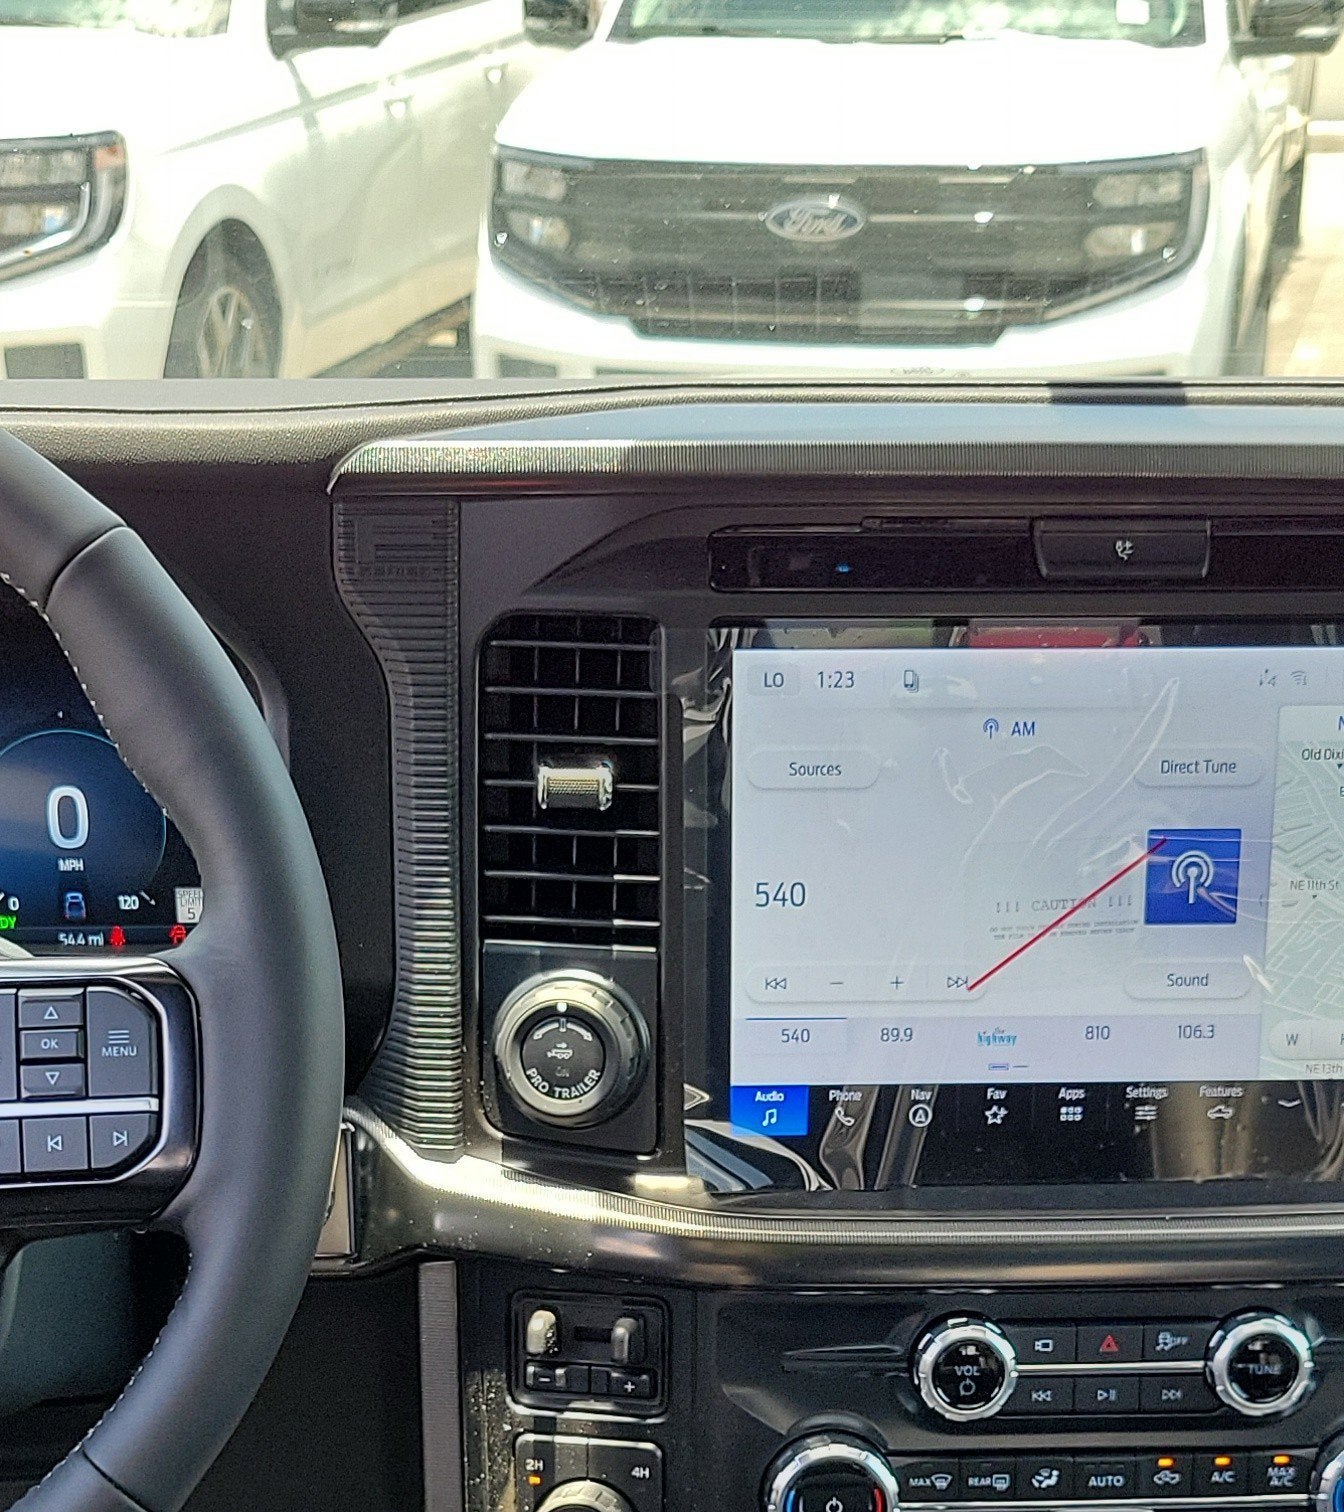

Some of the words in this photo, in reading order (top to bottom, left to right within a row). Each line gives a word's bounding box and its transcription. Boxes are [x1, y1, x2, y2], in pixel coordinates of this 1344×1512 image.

[762, 672, 785, 689] LO
[816, 671, 856, 689] 1:23
[1010, 721, 1037, 737] AM
[1301, 748, 1322, 761] Old
[788, 761, 843, 777] Sources
[1159, 759, 1200, 775] Direct
[1202, 759, 1238, 775] Tune
[46, 784, 90, 850] 0
[58, 858, 85, 872] MPH
[1289, 880, 1306, 891] NE
[1327, 880, 1340, 891] St
[754, 881, 807, 908] 540
[7, 896, 20, 911] 0
[118, 895, 140, 911] 120
[187, 907, 196, 920] 5
[87, 932, 104, 947] mi
[1166, 973, 1209, 987] Sound
[780, 1028, 811, 1043] 540
[879, 1027, 914, 1042] 89.9
[1085, 1025, 1111, 1040] 810
[1177, 1024, 1215, 1039] 106.3
[40, 1038, 60, 1050] OK
[977, 1030, 1017, 1047] highway
[1285, 1033, 1299, 1046] W
[101, 1046, 138, 1058] MENU
[1305, 1064, 1321, 1075] NE
[1322, 1064, 1343, 1075] 13th
[525, 1067, 550, 1094] PRO
[553, 1068, 602, 1099] TRAILER
[754, 1090, 785, 1103] Audio
[828, 1089, 863, 1102] Phone
[910, 1089, 933, 1101] Nav
[986, 1088, 1007, 1100] Fav
[1057, 1087, 1086, 1100] Apps
[1125, 1086, 1169, 1100] Settings
[1199, 1085, 1244, 1098] Features
[954, 1366, 981, 1378] VOL
[525, 1459, 544, 1471] 2H
[1267, 1466, 1296, 1477] MAX
[631, 1467, 650, 1479] 4H
[1211, 1470, 1236, 1483] A/C
[909, 1477, 931, 1487] MAX
[968, 1477, 992, 1487] REAR
[1088, 1475, 1125, 1488] AUTO
[1269, 1476, 1295, 1487] A/C
